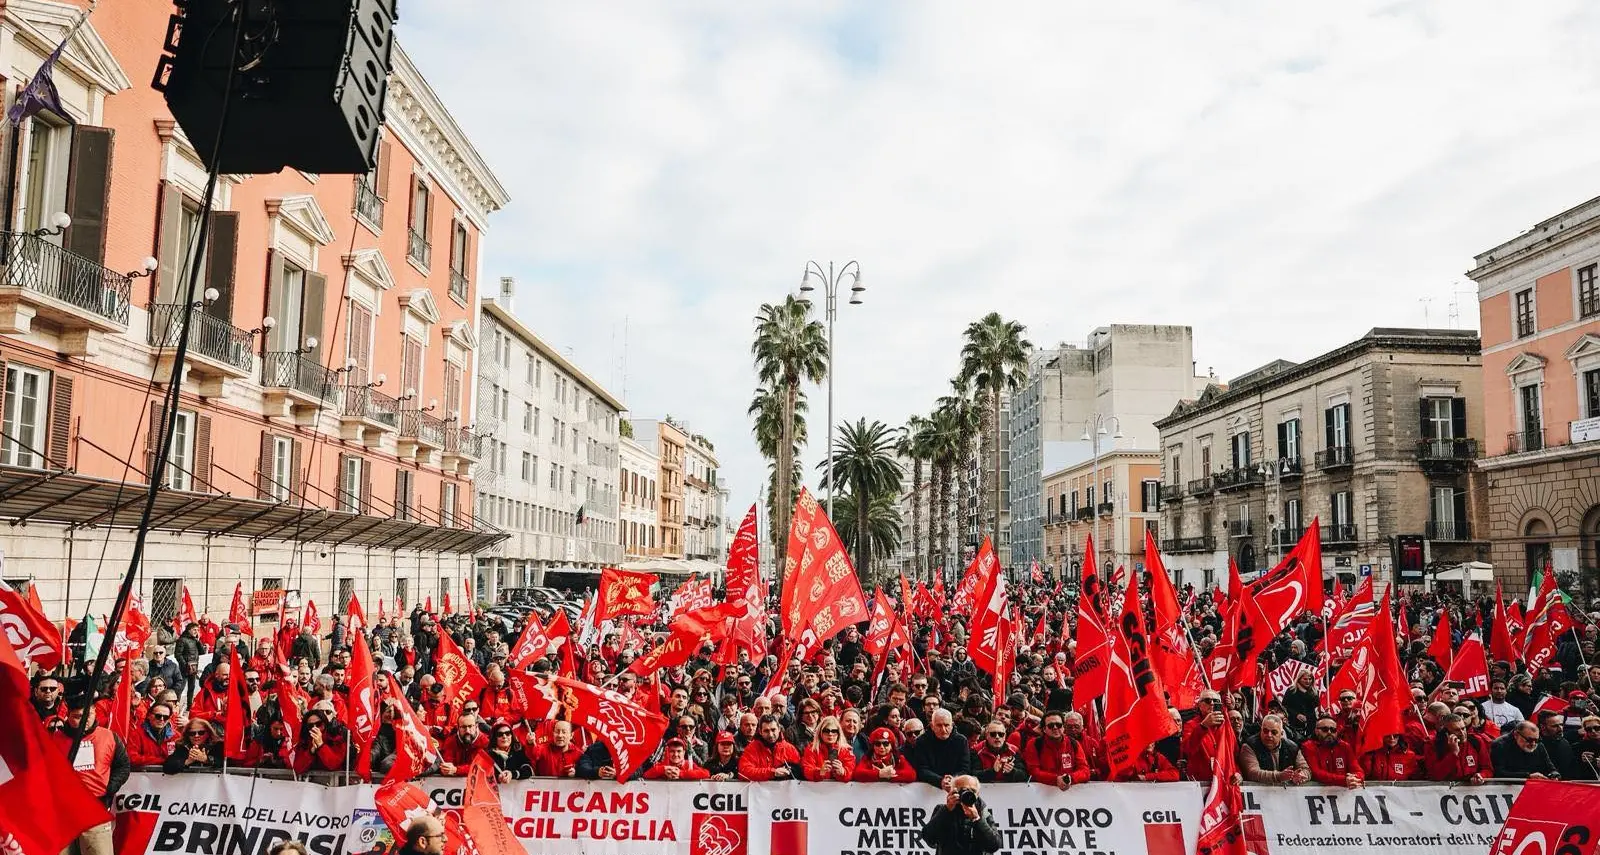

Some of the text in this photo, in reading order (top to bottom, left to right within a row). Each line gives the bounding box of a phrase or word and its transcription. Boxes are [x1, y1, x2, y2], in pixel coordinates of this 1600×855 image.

[1362, 566, 1370, 575] P
[1123, 611, 1155, 697] CGIL
[524, 790, 650, 814] FILCAMS
[692, 793, 748, 812] CGIL
[1304, 795, 1393, 826] FLAI
[168, 802, 350, 830] CAMERA DEL LAVORO
[771, 808, 809, 821] CGIL
[838, 807, 937, 827] CAMER
[1007, 808, 1113, 829] LAVORO
[1142, 810, 1182, 823] CGIL
[571, 818, 677, 842] PUGLIA
[1084, 829, 1098, 849] E
[1277, 833, 1363, 847] Federazione
[1366, 833, 1442, 847] Lavoratori
